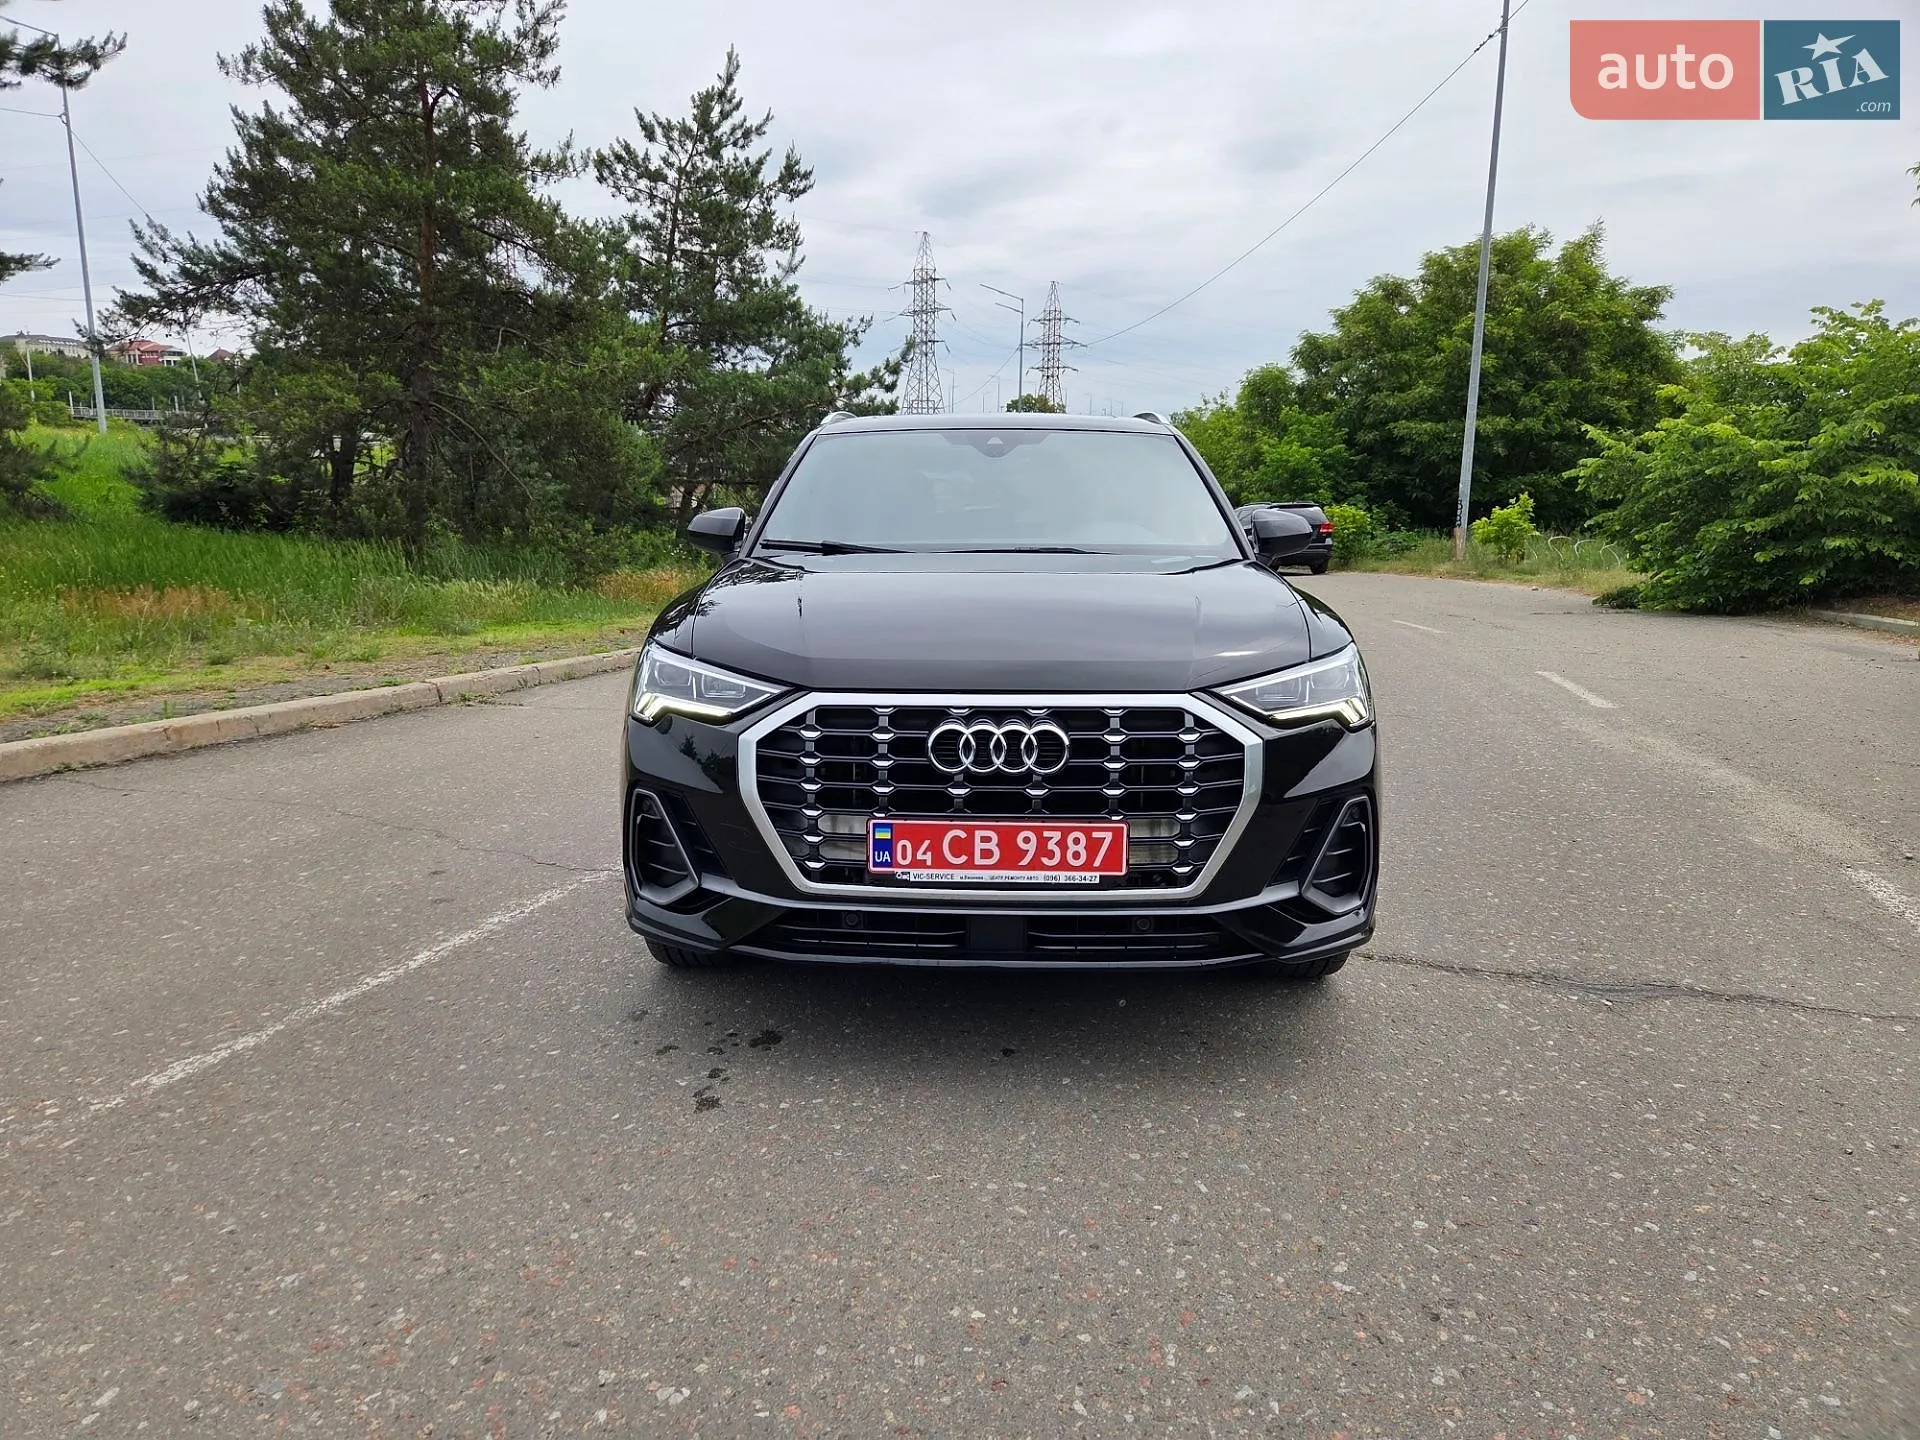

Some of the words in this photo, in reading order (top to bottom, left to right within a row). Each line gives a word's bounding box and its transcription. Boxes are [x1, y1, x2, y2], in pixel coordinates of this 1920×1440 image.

[896, 839, 932, 866] 04
[942, 829, 1000, 866] CB
[1016, 830, 1113, 868] 9387
[874, 851, 891, 863] UA
[912, 872, 955, 881] VIC-SERVICE
